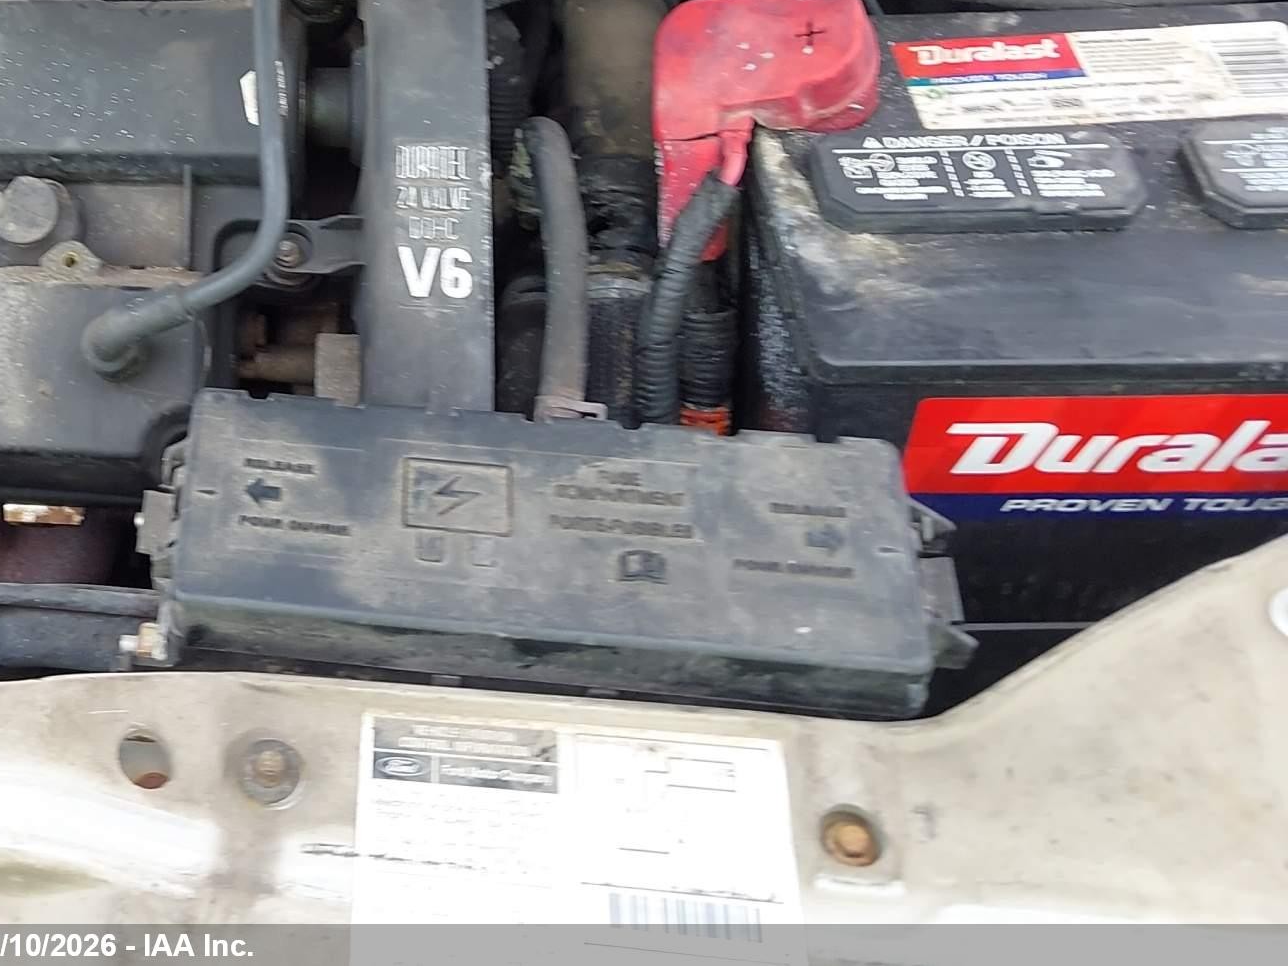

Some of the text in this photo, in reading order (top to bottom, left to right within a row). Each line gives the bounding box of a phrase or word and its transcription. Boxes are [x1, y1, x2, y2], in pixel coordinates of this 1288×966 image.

[908, 39, 1060, 65] Duralast
[881, 135, 967, 149] DANGER
[984, 134, 1067, 145] POISON
[397, 246, 473, 299] V6
[999, 498, 1173, 512] PROVEN
